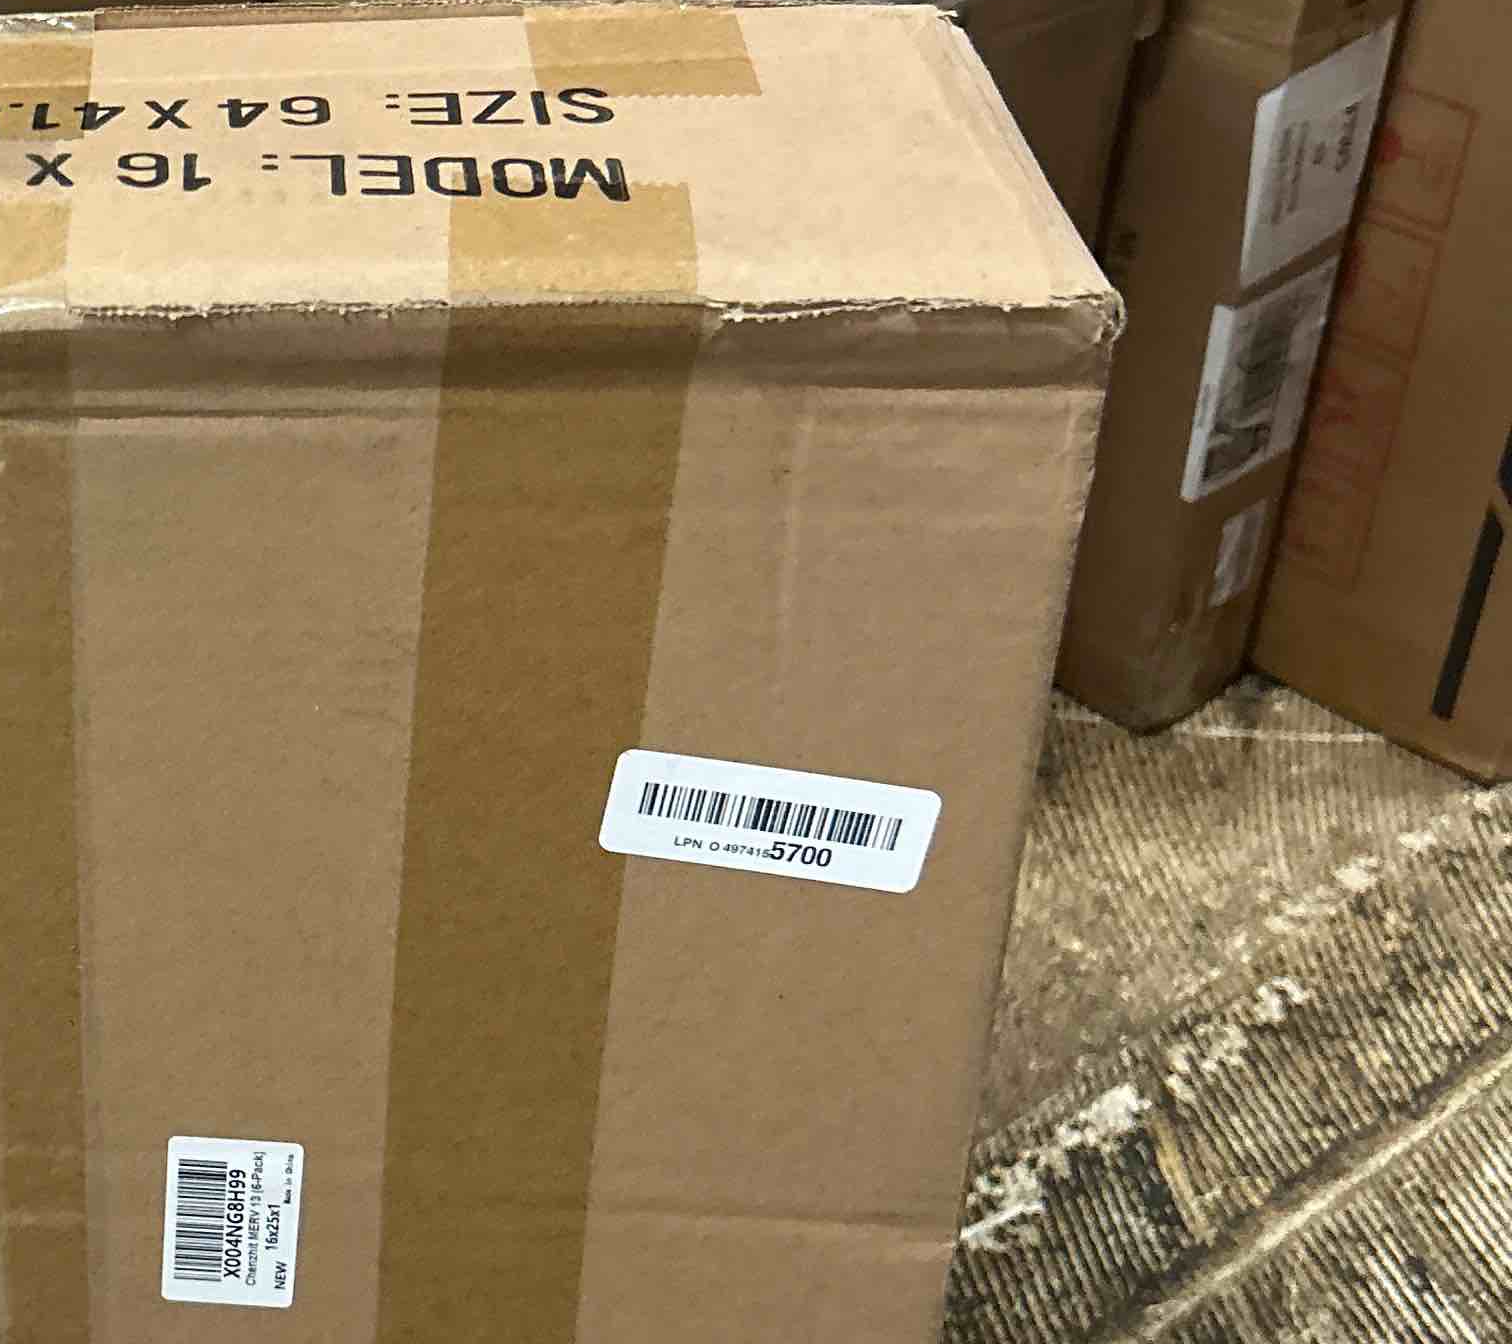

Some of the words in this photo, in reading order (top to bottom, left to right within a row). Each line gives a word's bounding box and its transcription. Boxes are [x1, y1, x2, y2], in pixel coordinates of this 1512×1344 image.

[218, 95, 332, 129] 64
[385, 87, 616, 126] SIZE:
[25, 152, 74, 188] X
[116, 152, 212, 192] 16
[261, 153, 631, 202] MODEL:
[673, 835, 703, 850] LPN
[251, 1151, 266, 1194] (6-Pack)
[223, 1168, 247, 1279] X004NG8H99
[247, 1209, 261, 1241] MERV
[265, 1203, 281, 1251] 16x25x1
[274, 1261, 288, 1291] NEW
